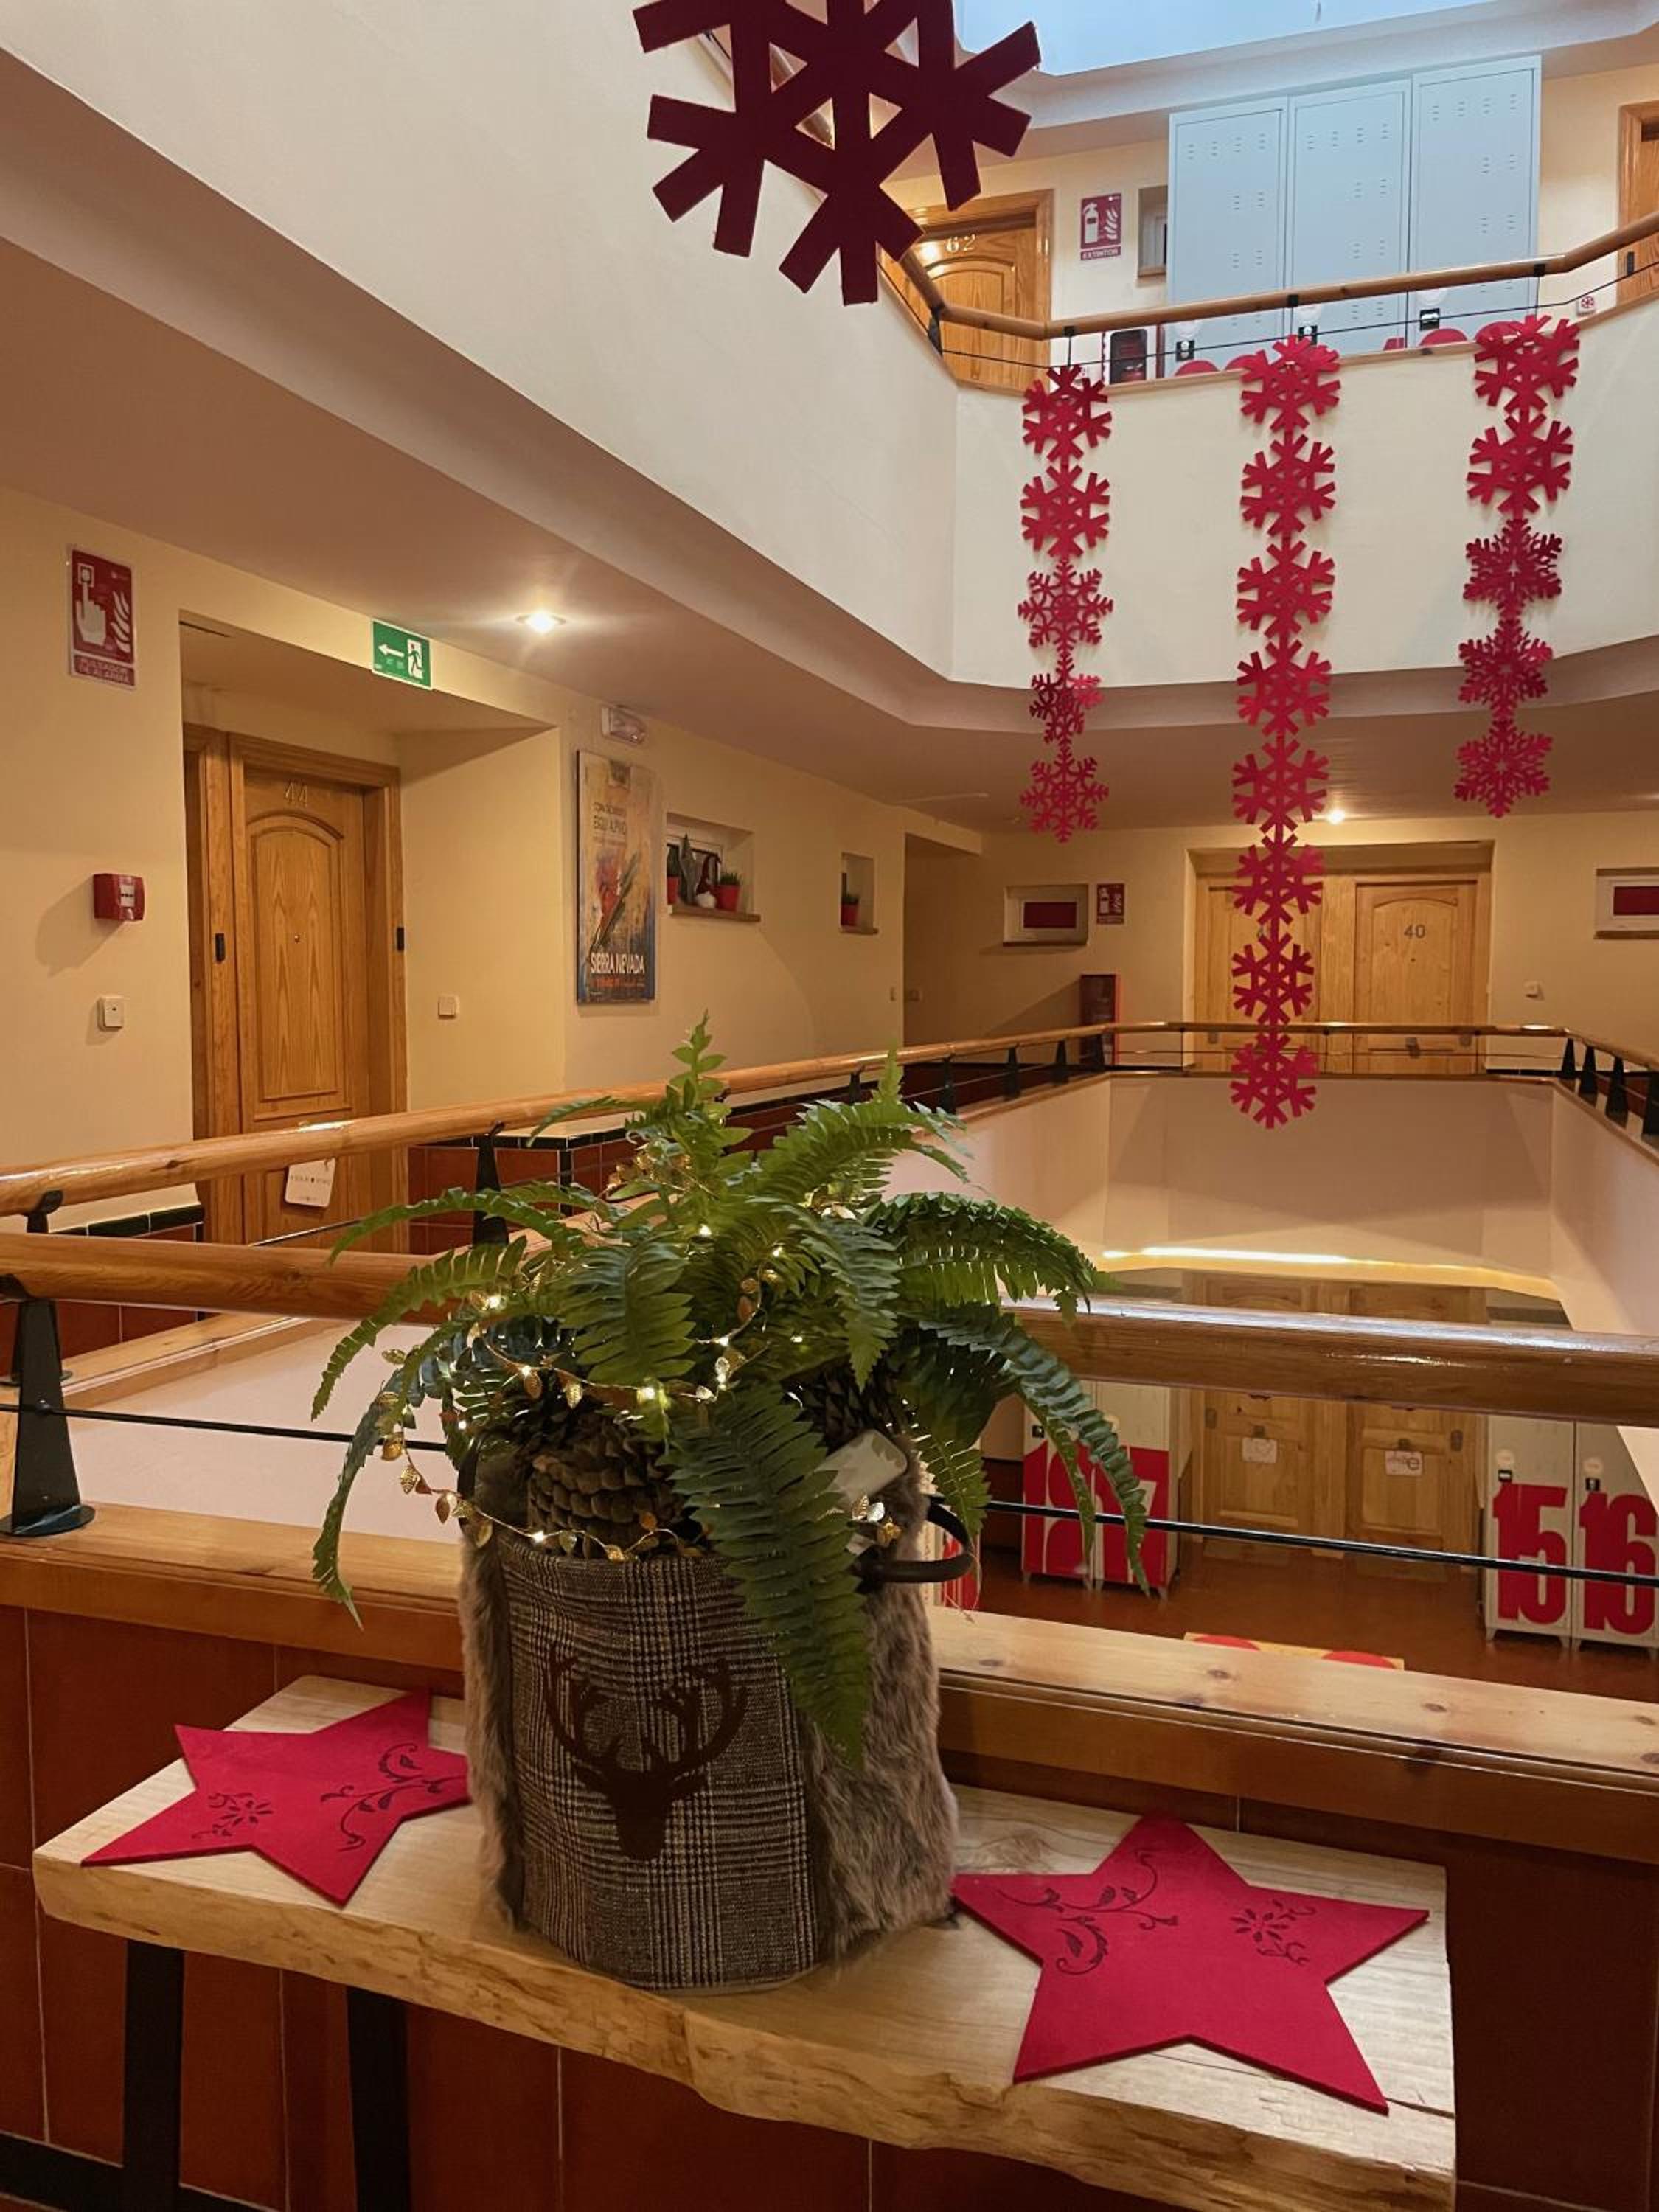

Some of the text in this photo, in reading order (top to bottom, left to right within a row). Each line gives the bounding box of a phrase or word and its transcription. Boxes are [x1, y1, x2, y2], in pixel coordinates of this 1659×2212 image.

[591, 952, 645, 974] SIERRA NEVADA
[1403, 924, 1426, 939] 40
[1492, 1482, 1568, 1625] 15
[1579, 1492, 1658, 1635] 16
